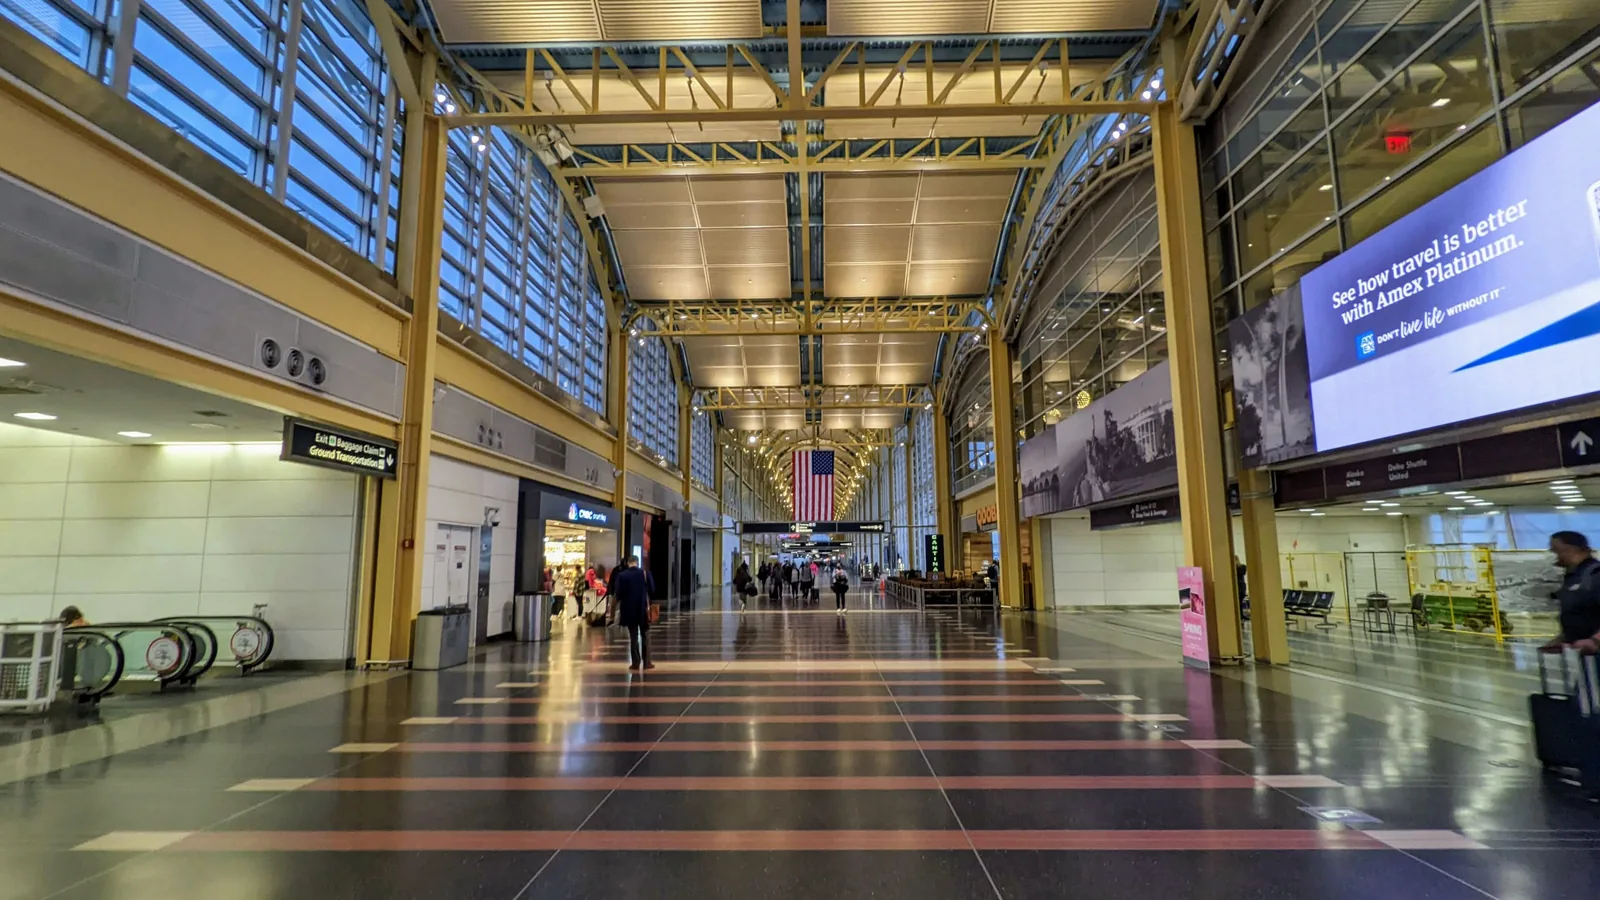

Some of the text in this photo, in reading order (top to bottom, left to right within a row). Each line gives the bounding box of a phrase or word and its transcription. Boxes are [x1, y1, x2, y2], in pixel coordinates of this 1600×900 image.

[1332, 199, 1528, 309] See how travel is better
[1341, 233, 1524, 324] with Amex Platinum.
[1377, 287, 1500, 344] DON'T live life WITHOUT IT
[316, 433, 378, 455] Exit Baggage Claim
[310, 446, 377, 467] Ground Transportation
[1406, 459, 1427, 469] Shuttle
[1389, 472, 1408, 480] United
[977, 503, 997, 529] QDOB
